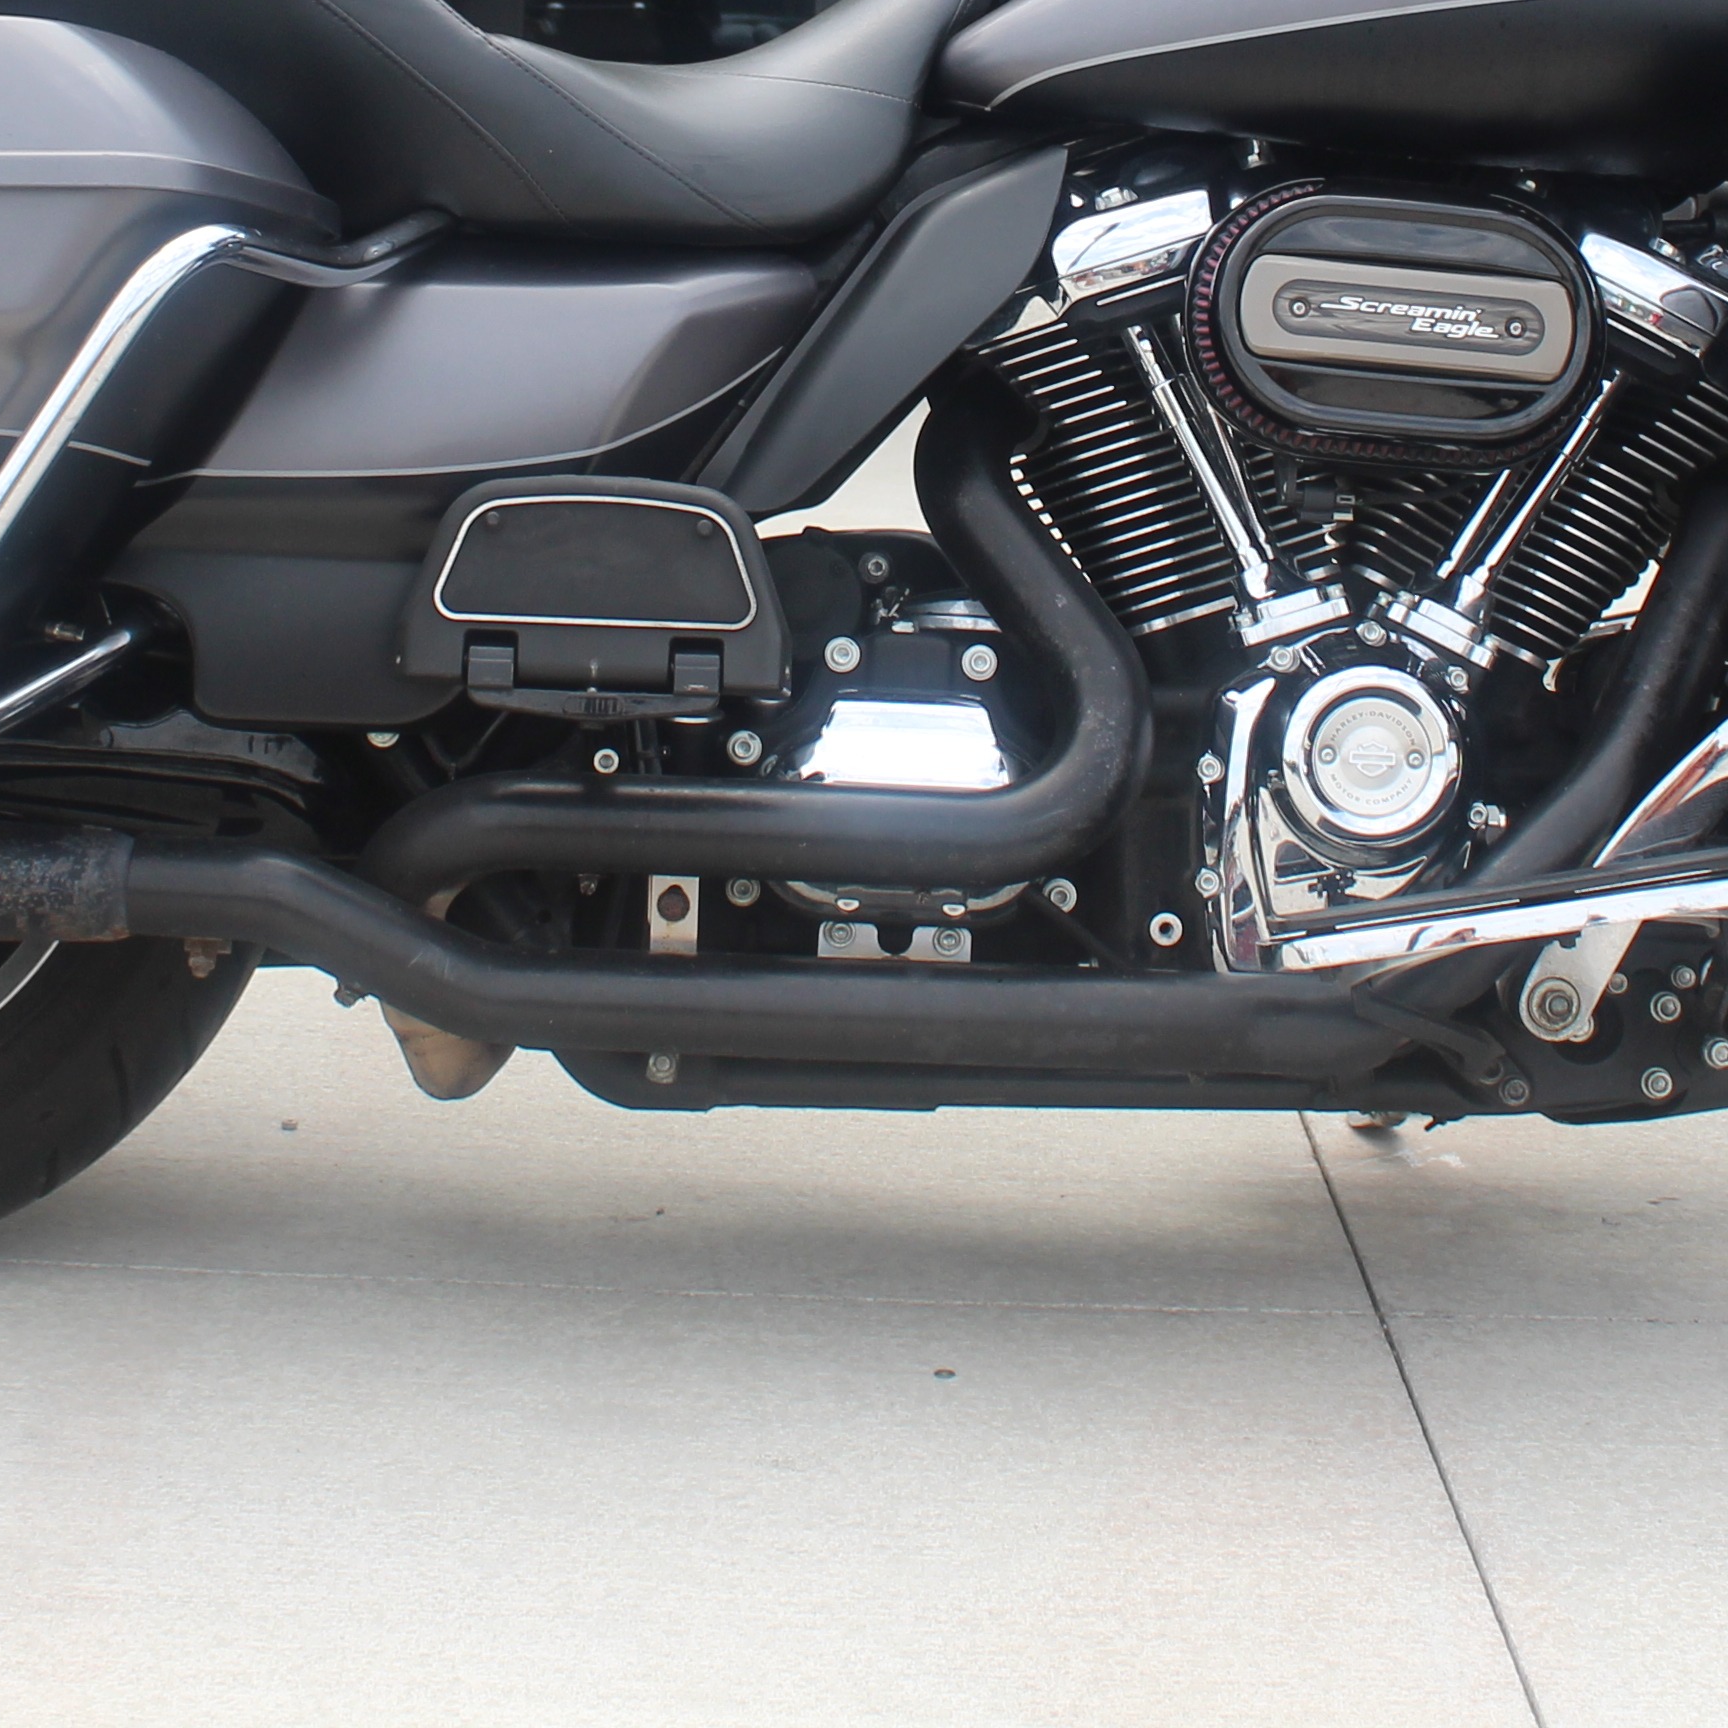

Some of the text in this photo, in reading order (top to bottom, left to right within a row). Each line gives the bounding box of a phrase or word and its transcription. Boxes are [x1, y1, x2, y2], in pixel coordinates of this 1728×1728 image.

[1409, 316, 1500, 339] Eagle
[1330, 773, 1414, 806] MOTOR COMPANY
